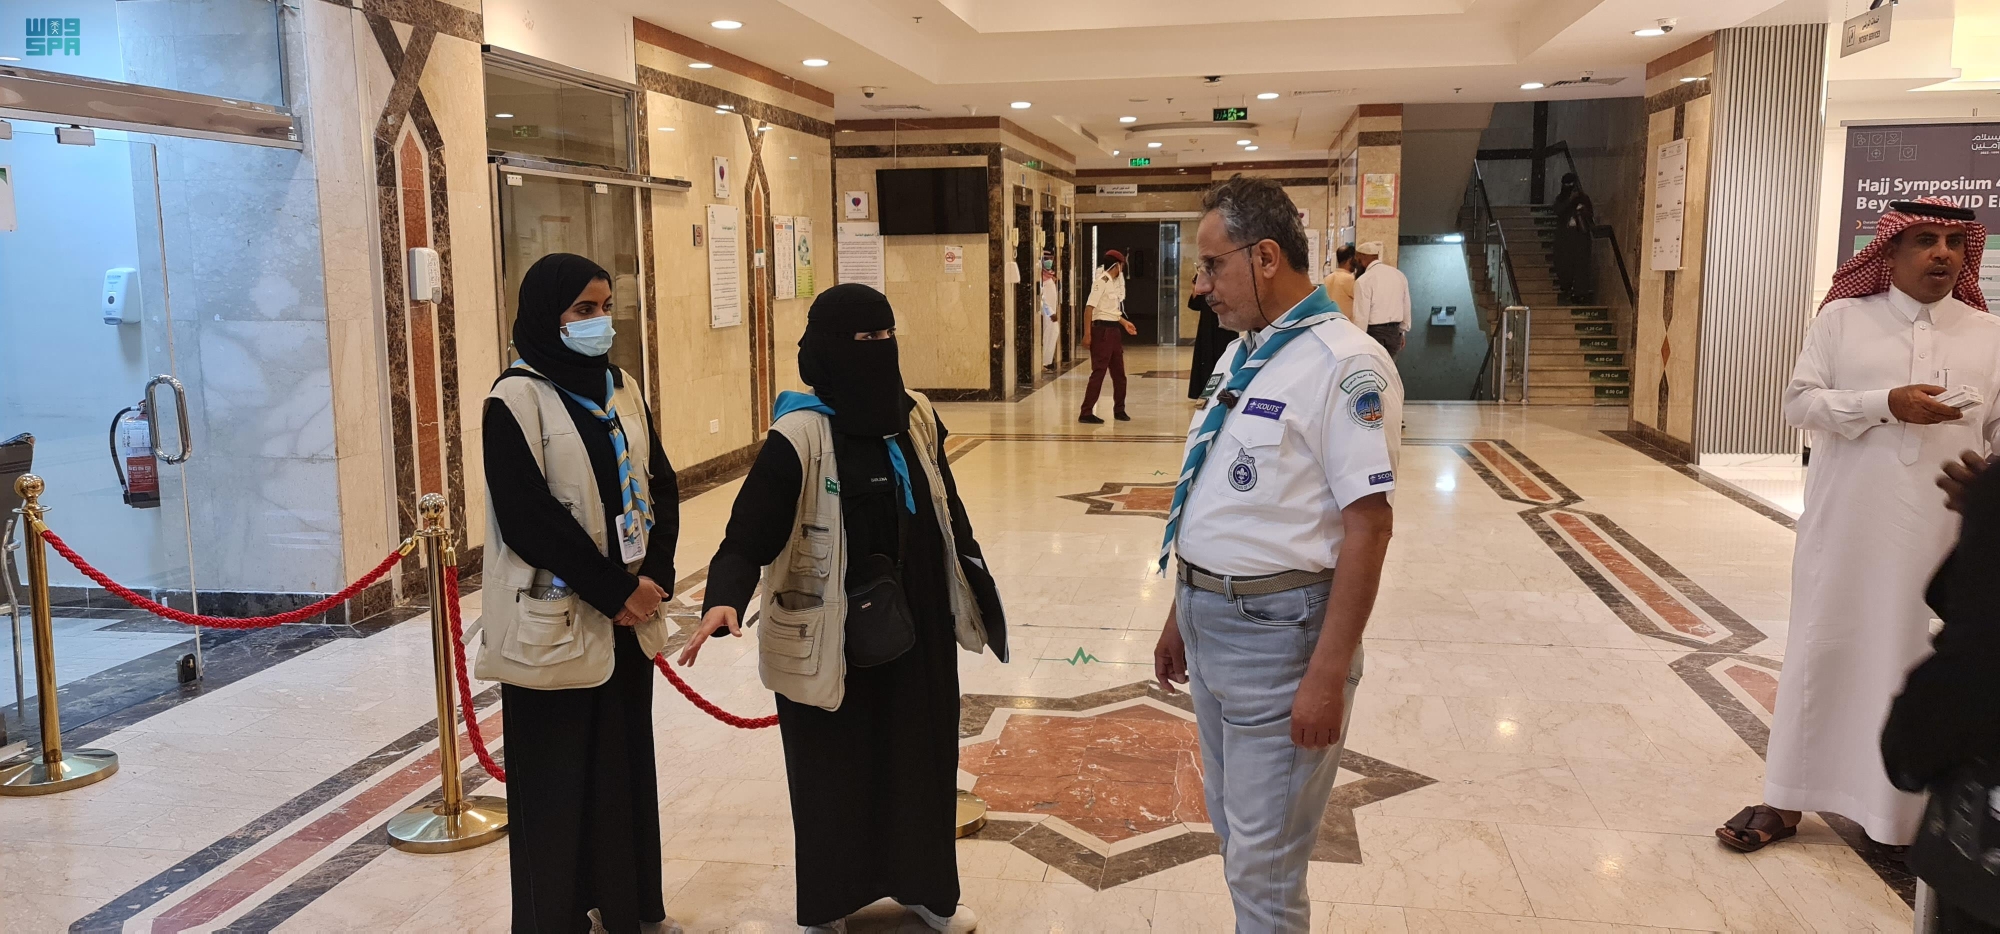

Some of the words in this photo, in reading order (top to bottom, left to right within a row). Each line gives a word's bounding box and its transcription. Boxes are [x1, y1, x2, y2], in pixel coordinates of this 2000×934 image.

[1857, 177, 1890, 195] Hajj
[1893, 176, 1992, 194] Symposium
[1988, 195, 2000, 208] E
[1255, 403, 1281, 413] SCOUTS
